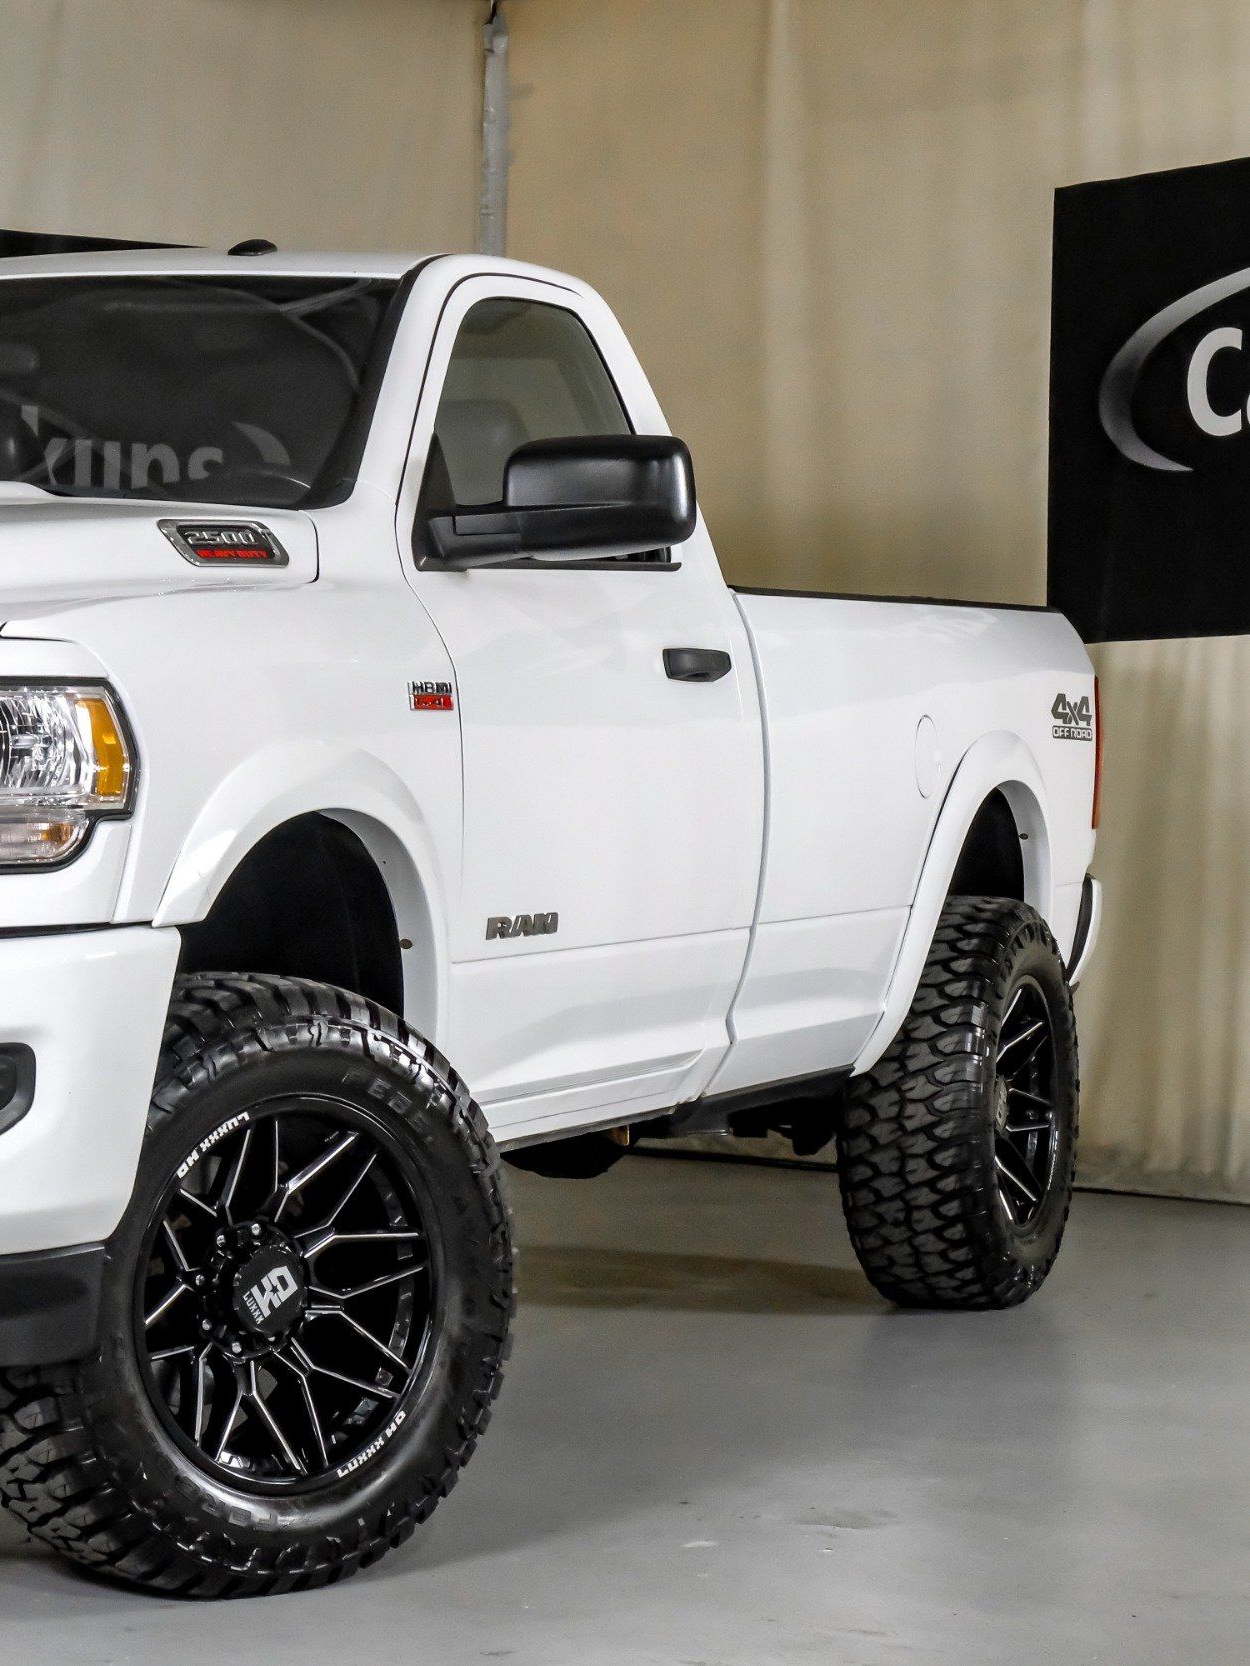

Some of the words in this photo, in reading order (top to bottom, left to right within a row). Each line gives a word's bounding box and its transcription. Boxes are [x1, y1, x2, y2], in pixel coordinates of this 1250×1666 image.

[1187, 326, 1250, 437] C
[184, 531, 257, 545] 2500
[1053, 727, 1070, 738] OFF
[1070, 728, 1092, 739] ROAD
[486, 912, 558, 940] RAM
[199, 1111, 250, 1152] LUXXX
[176, 1149, 200, 1179] HD
[243, 1291, 265, 1324] LUXXX
[336, 1436, 385, 1478] LUXXX
[385, 1410, 406, 1438] HD
